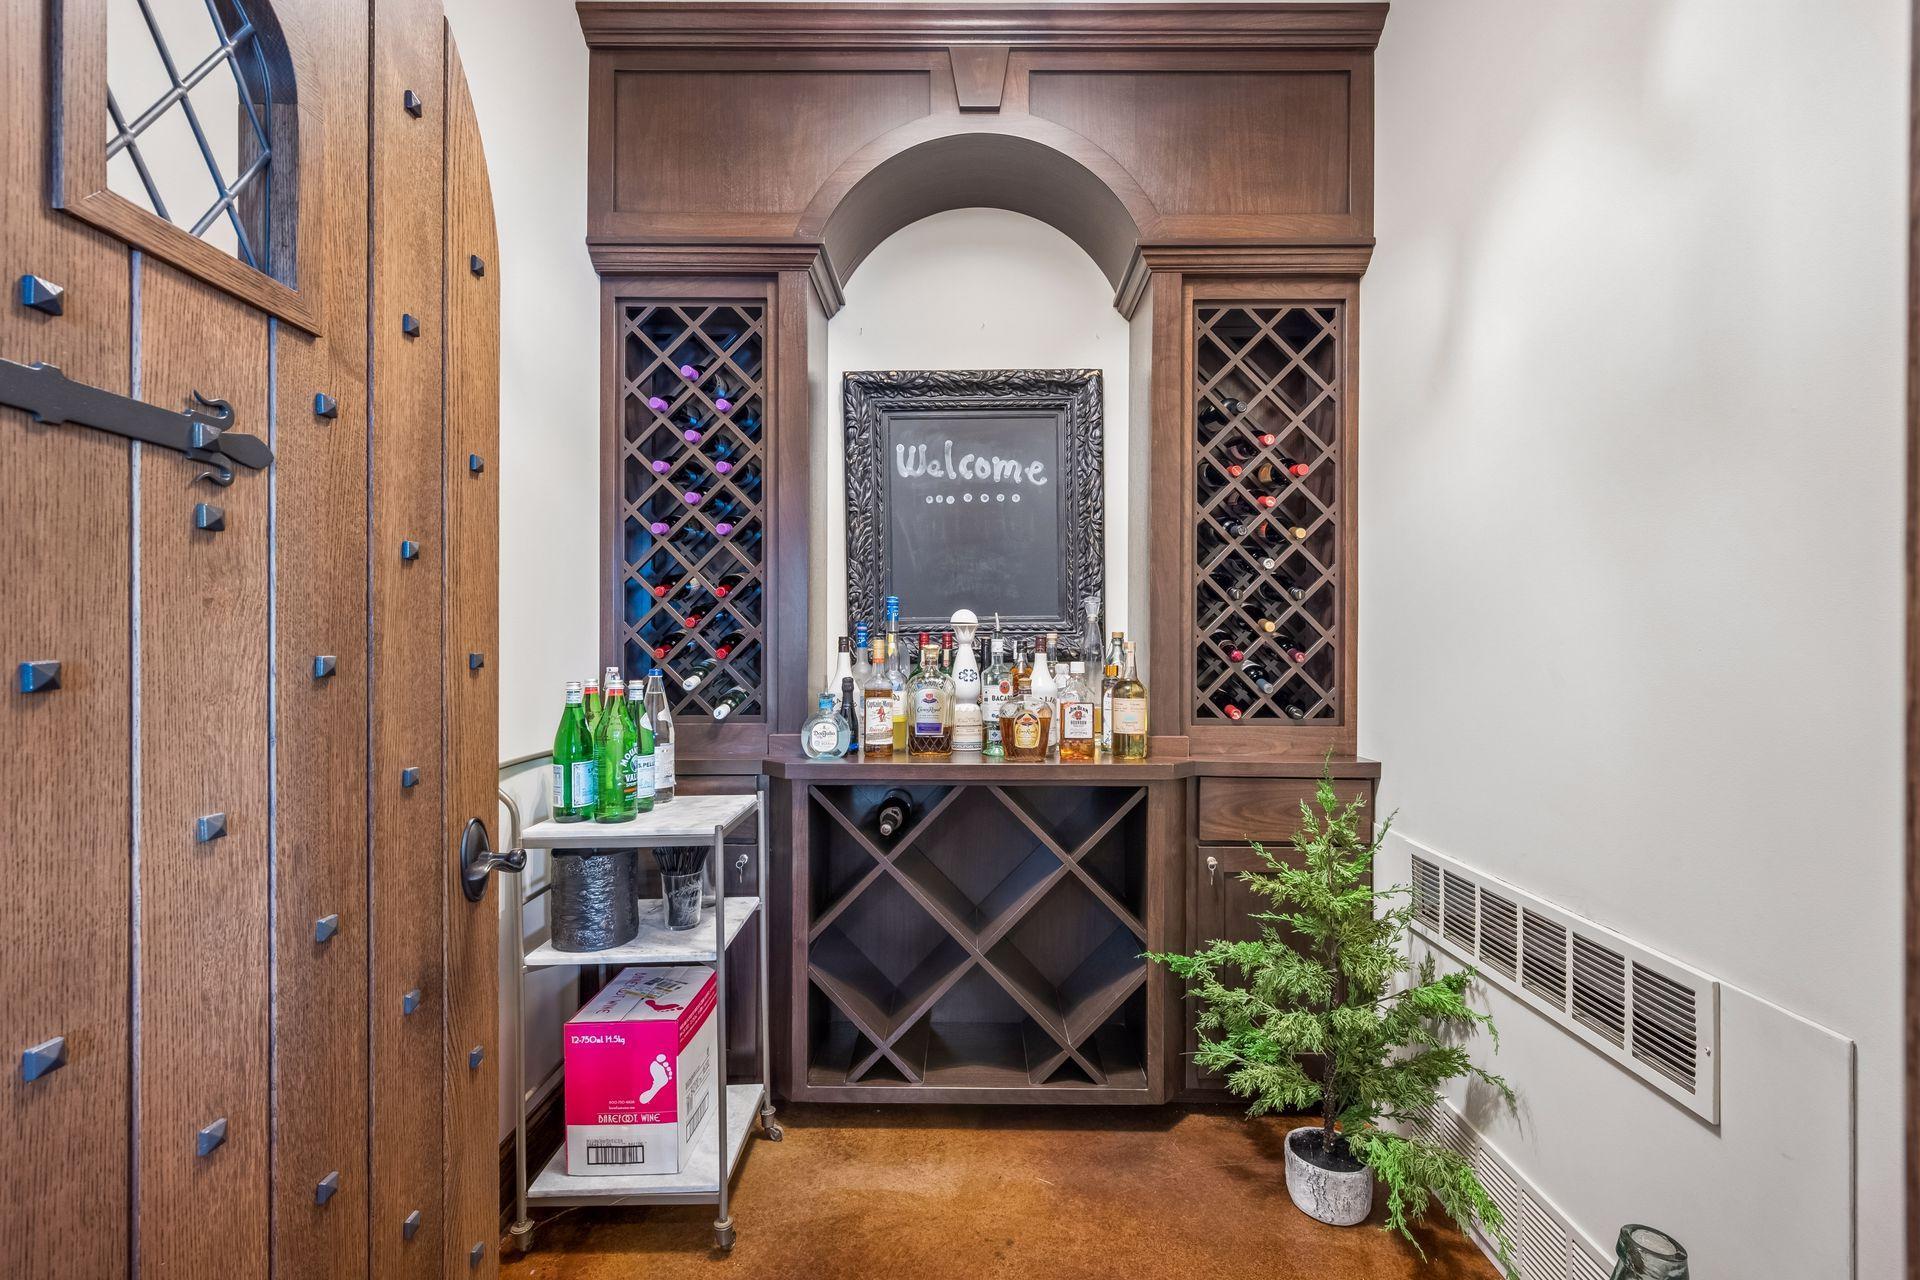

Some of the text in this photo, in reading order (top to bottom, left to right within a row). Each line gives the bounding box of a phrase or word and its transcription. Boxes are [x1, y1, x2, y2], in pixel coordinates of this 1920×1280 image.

[896, 440, 1048, 485] Welcome
[598, 1113, 661, 1124] BAREFOOT WINE
